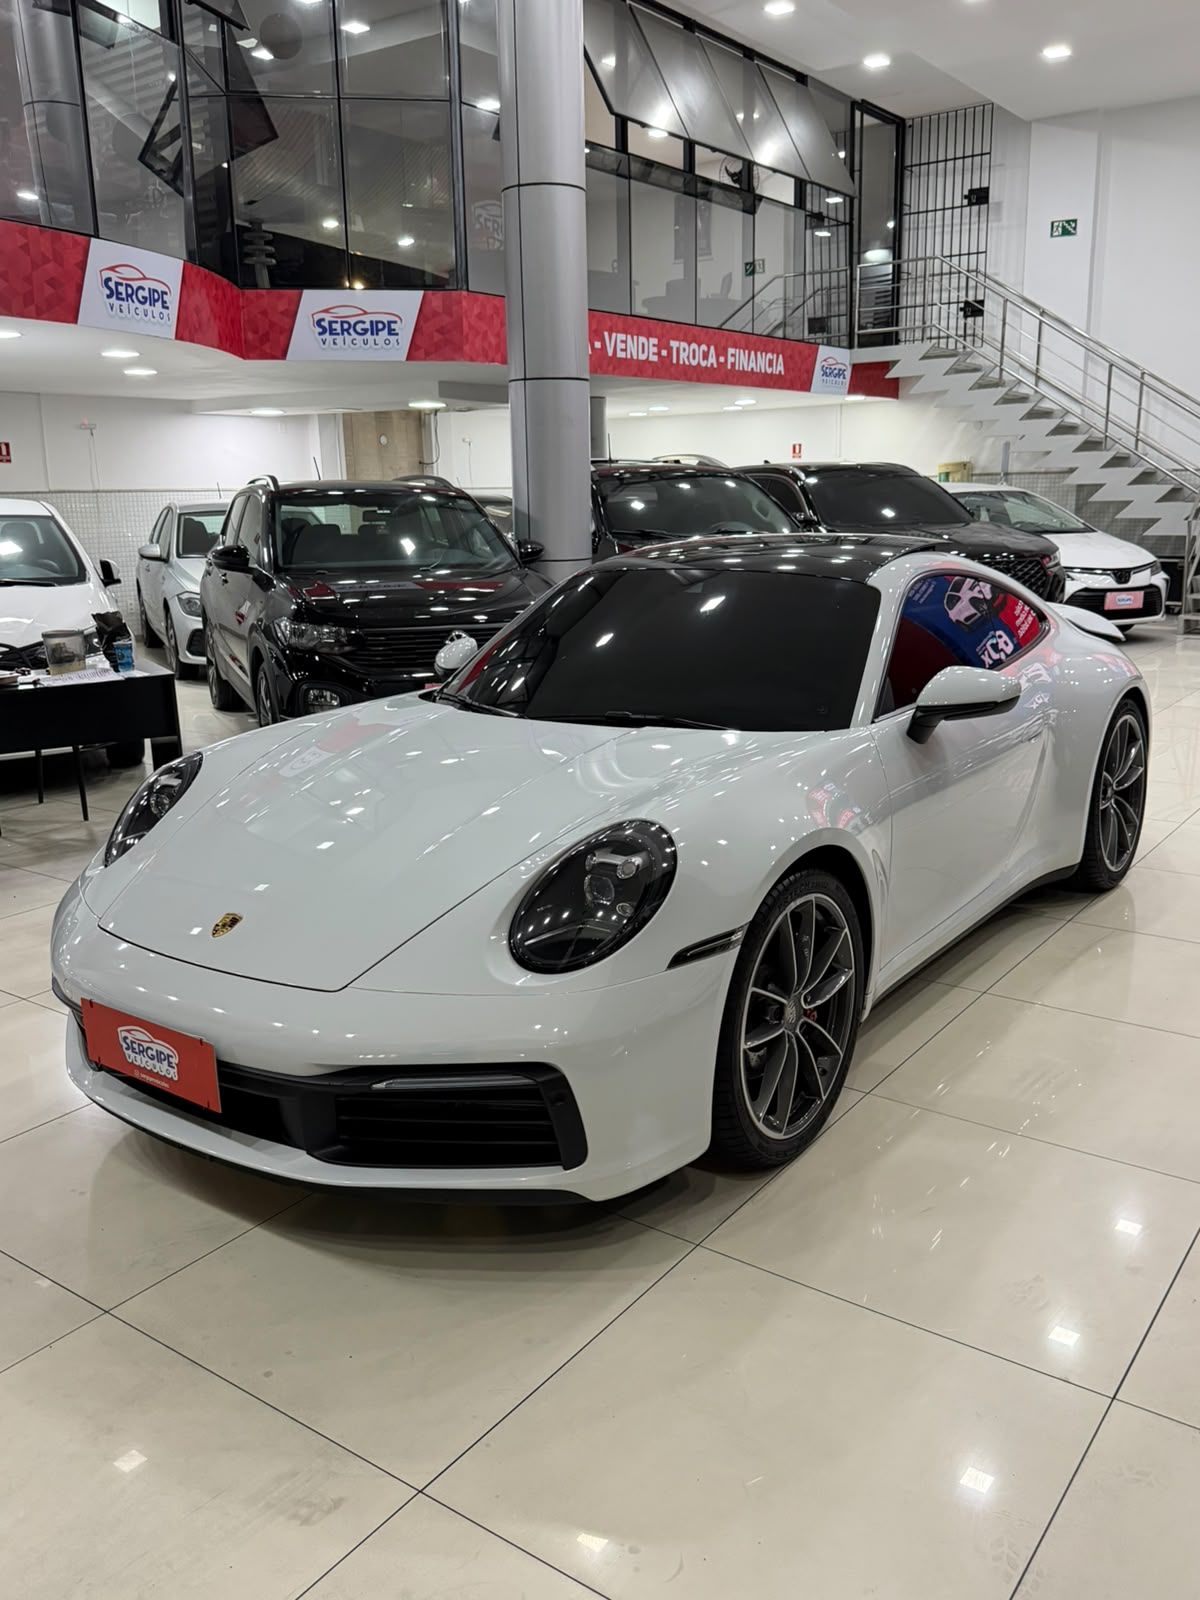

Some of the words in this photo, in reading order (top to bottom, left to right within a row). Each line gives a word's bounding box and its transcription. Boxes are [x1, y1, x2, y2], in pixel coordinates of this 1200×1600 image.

[103, 276, 170, 311] SERGIPE
[315, 317, 400, 337] SERGIPE
[603, 331, 659, 362] VENDE
[669, 340, 718, 369] TROCA
[727, 347, 785, 376] FINANCIA
[122, 1035, 176, 1070] SERGIPE
